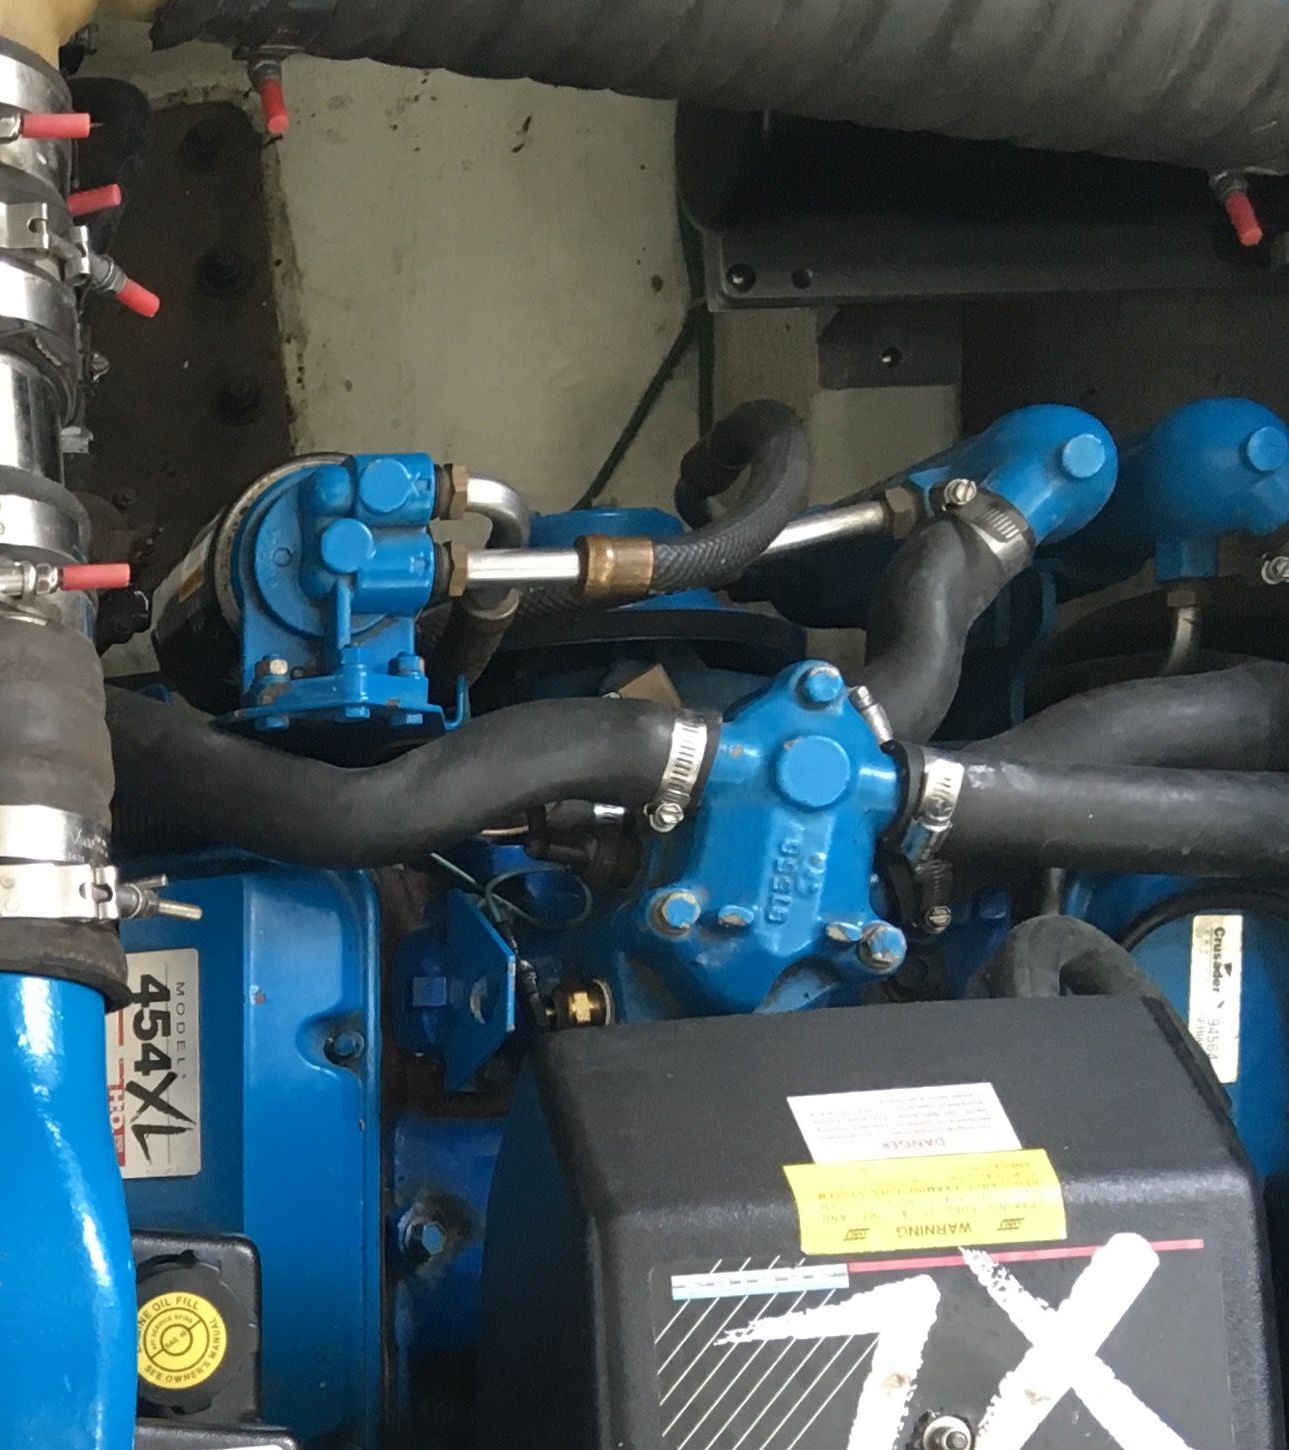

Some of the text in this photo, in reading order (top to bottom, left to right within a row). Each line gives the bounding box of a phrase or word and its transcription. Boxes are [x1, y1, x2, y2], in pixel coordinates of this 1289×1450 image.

[1212, 927, 1226, 993] Crusader
[176, 982, 186, 1066] MODEL
[125, 974, 196, 1165] 454XL
[881, 1137, 946, 1149] DANGER
[896, 1222, 972, 1238] WARNING
[152, 1297, 171, 1311] OIL
[176, 1296, 198, 1310] FILL
[144, 1317, 221, 1383] SEE OWNER'S MANUAL
